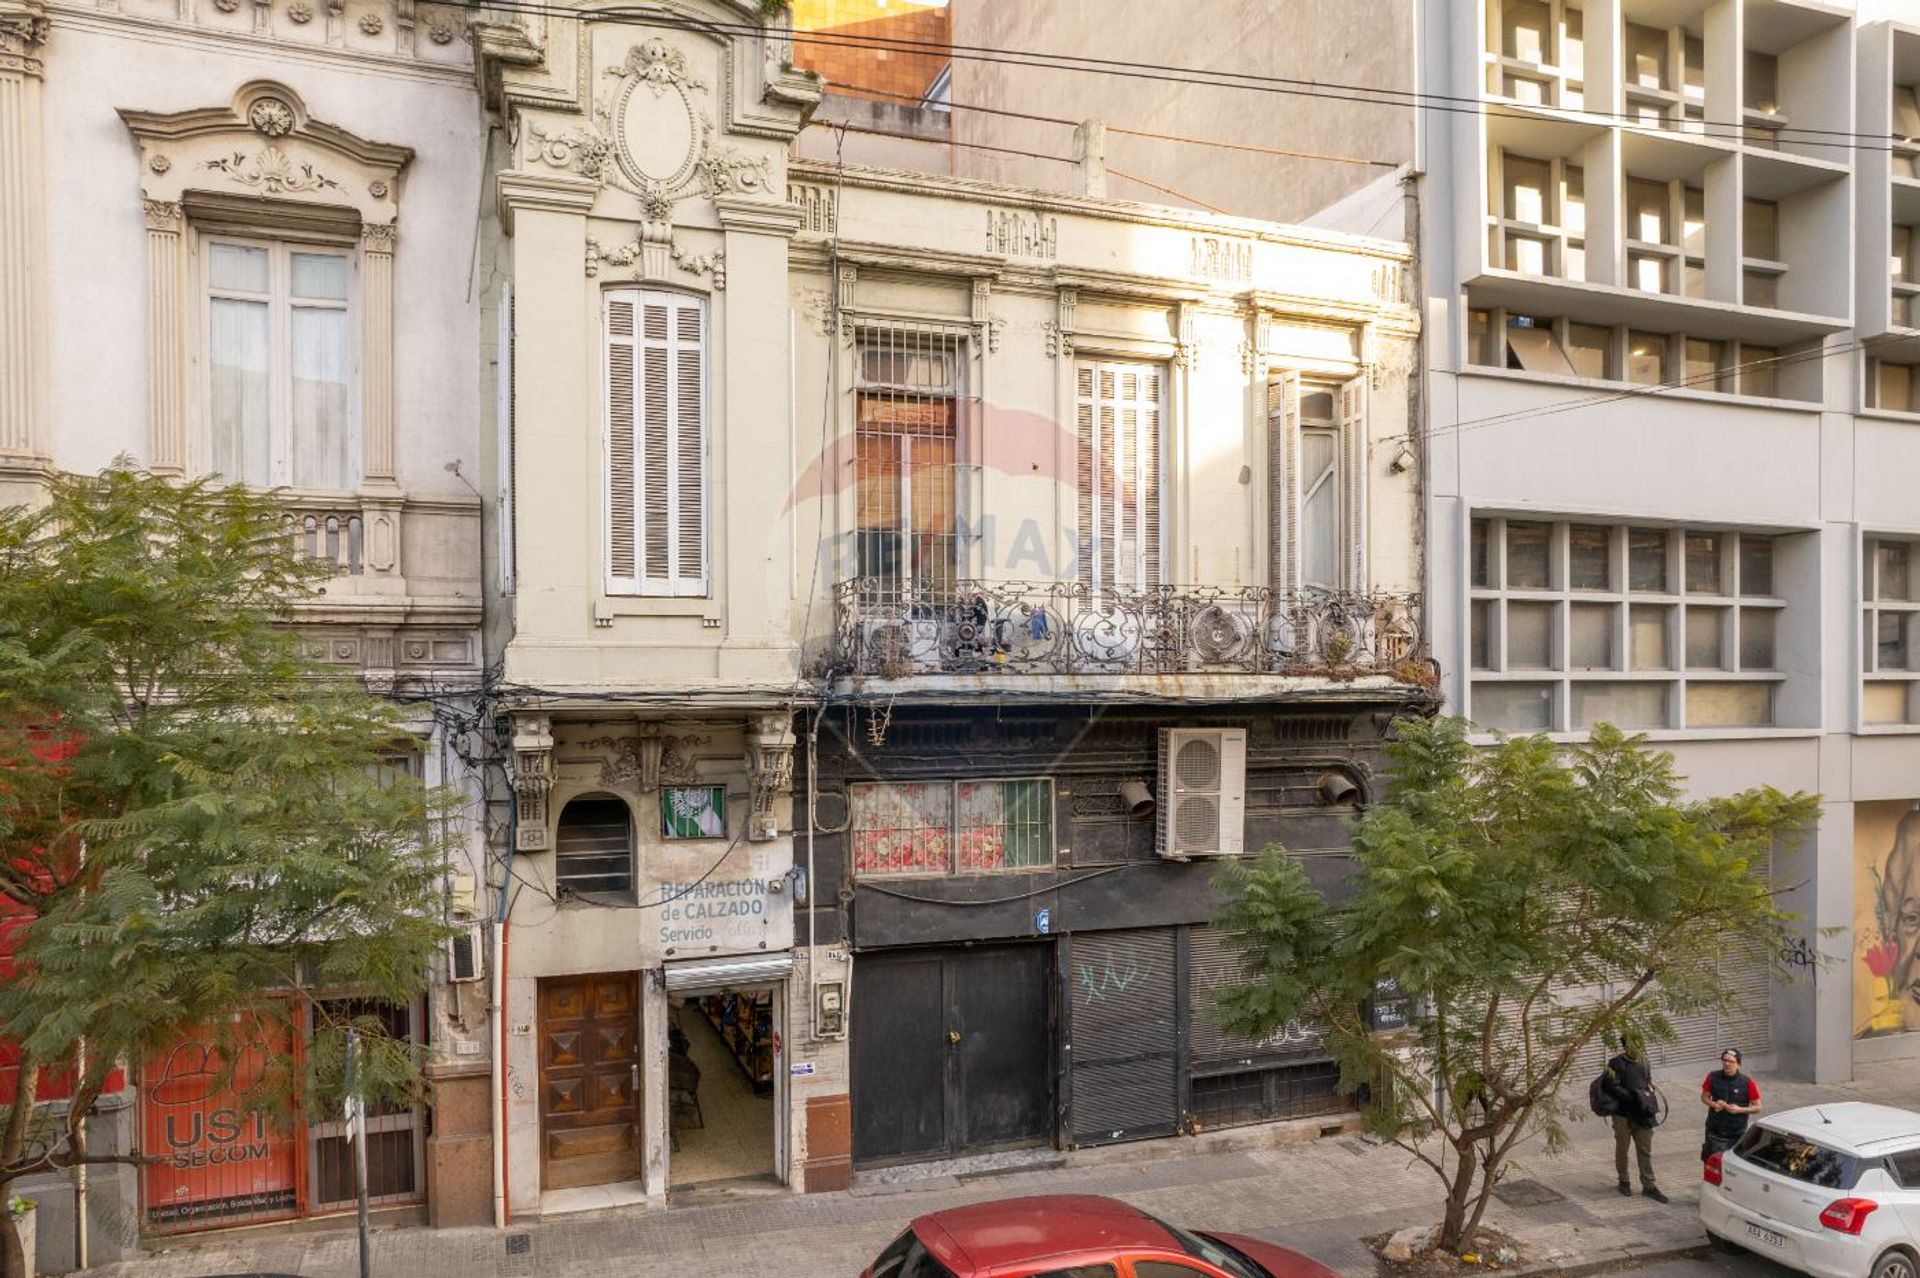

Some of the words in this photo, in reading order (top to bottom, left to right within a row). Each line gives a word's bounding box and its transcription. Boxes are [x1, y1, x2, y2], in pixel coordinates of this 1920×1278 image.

[660, 877, 765, 902] REPARACIÓN
[661, 908, 680, 922] de
[684, 899, 763, 920] CALZADO
[660, 926, 713, 943] Servicio
[173, 1143, 269, 1169] SECOM
